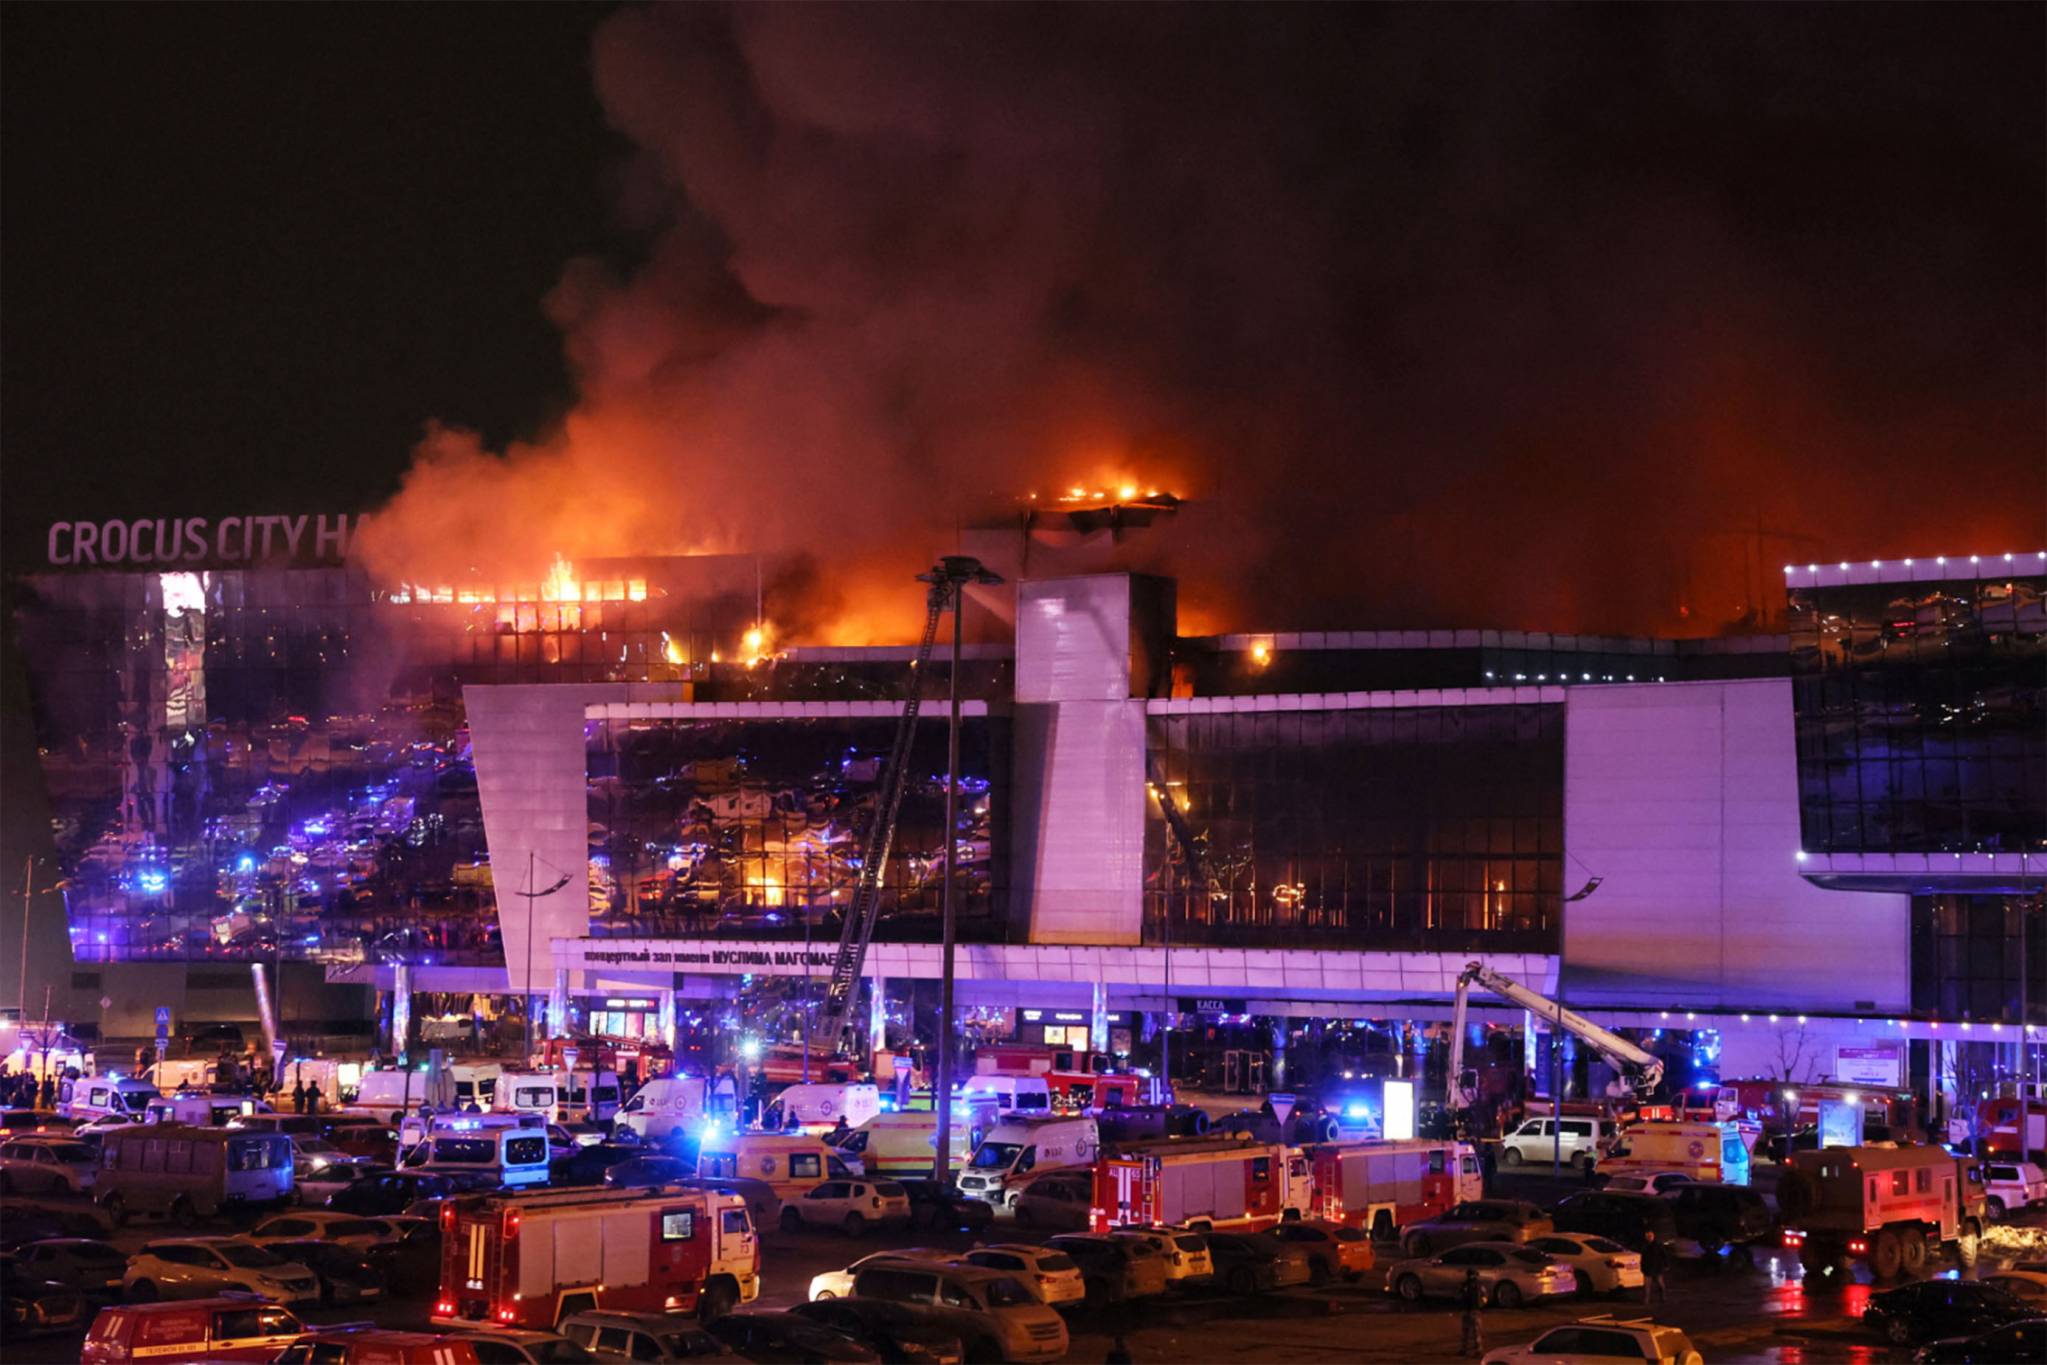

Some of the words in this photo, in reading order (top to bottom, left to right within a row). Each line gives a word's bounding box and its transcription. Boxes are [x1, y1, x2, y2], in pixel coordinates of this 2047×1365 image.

[48, 517, 208, 565] CROCUS
[217, 514, 308, 560] CITY
[652, 952, 672, 963] зал
[712, 950, 773, 966] МУСЛИМА
[774, 951, 840, 967] МАГОМАЕ
[1197, 999, 1225, 1010] КАССА
